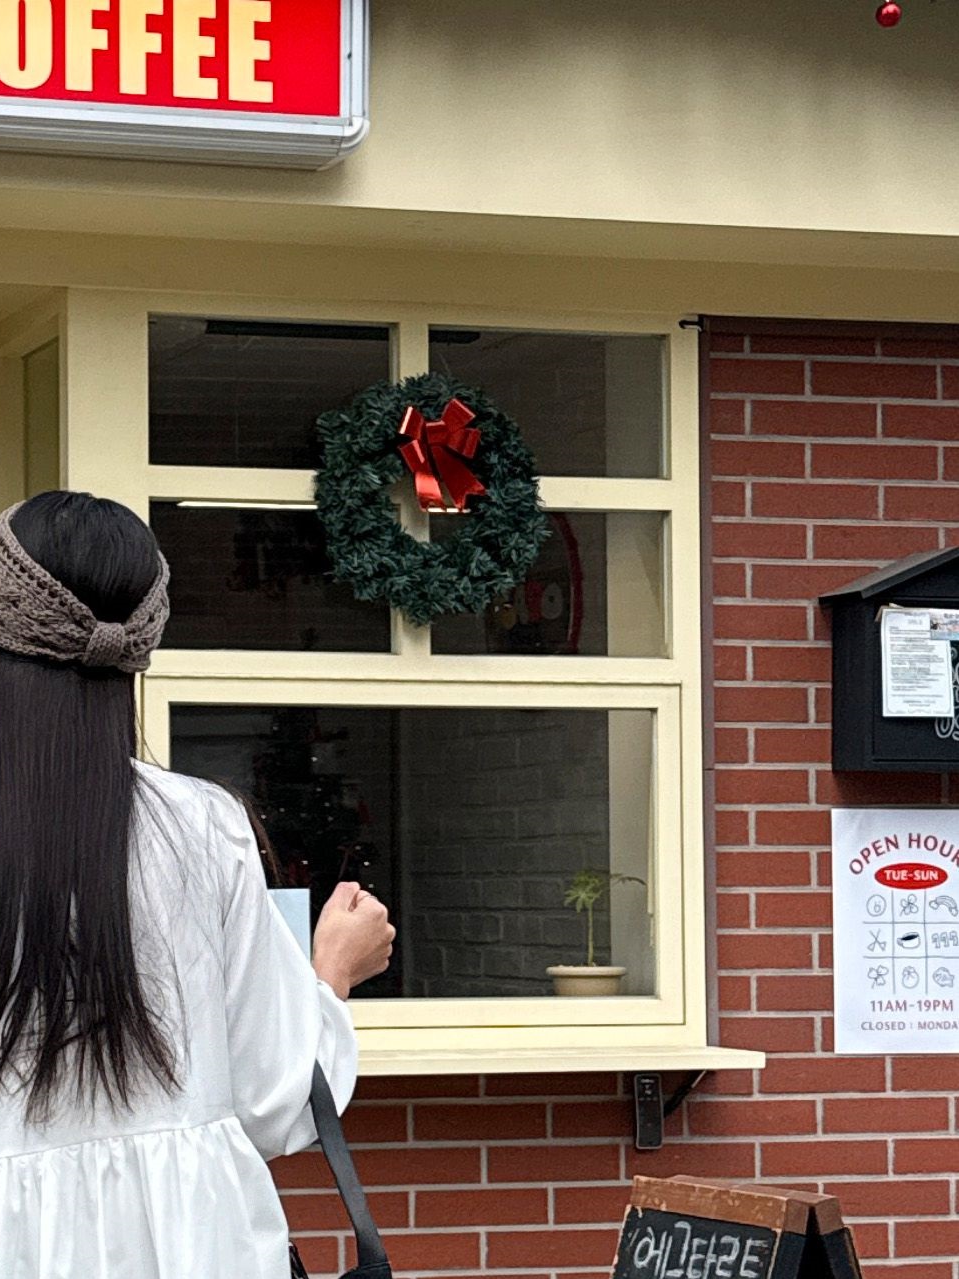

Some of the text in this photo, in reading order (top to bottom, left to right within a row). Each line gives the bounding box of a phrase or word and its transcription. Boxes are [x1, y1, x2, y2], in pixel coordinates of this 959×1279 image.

[848, 833, 900, 876] OPEN
[884, 869, 939, 882] TUE-SUN
[870, 999, 955, 1013] 11AM-19PM
[861, 1021, 906, 1031] CLOSED
[917, 1020, 959, 1031] MONDA
